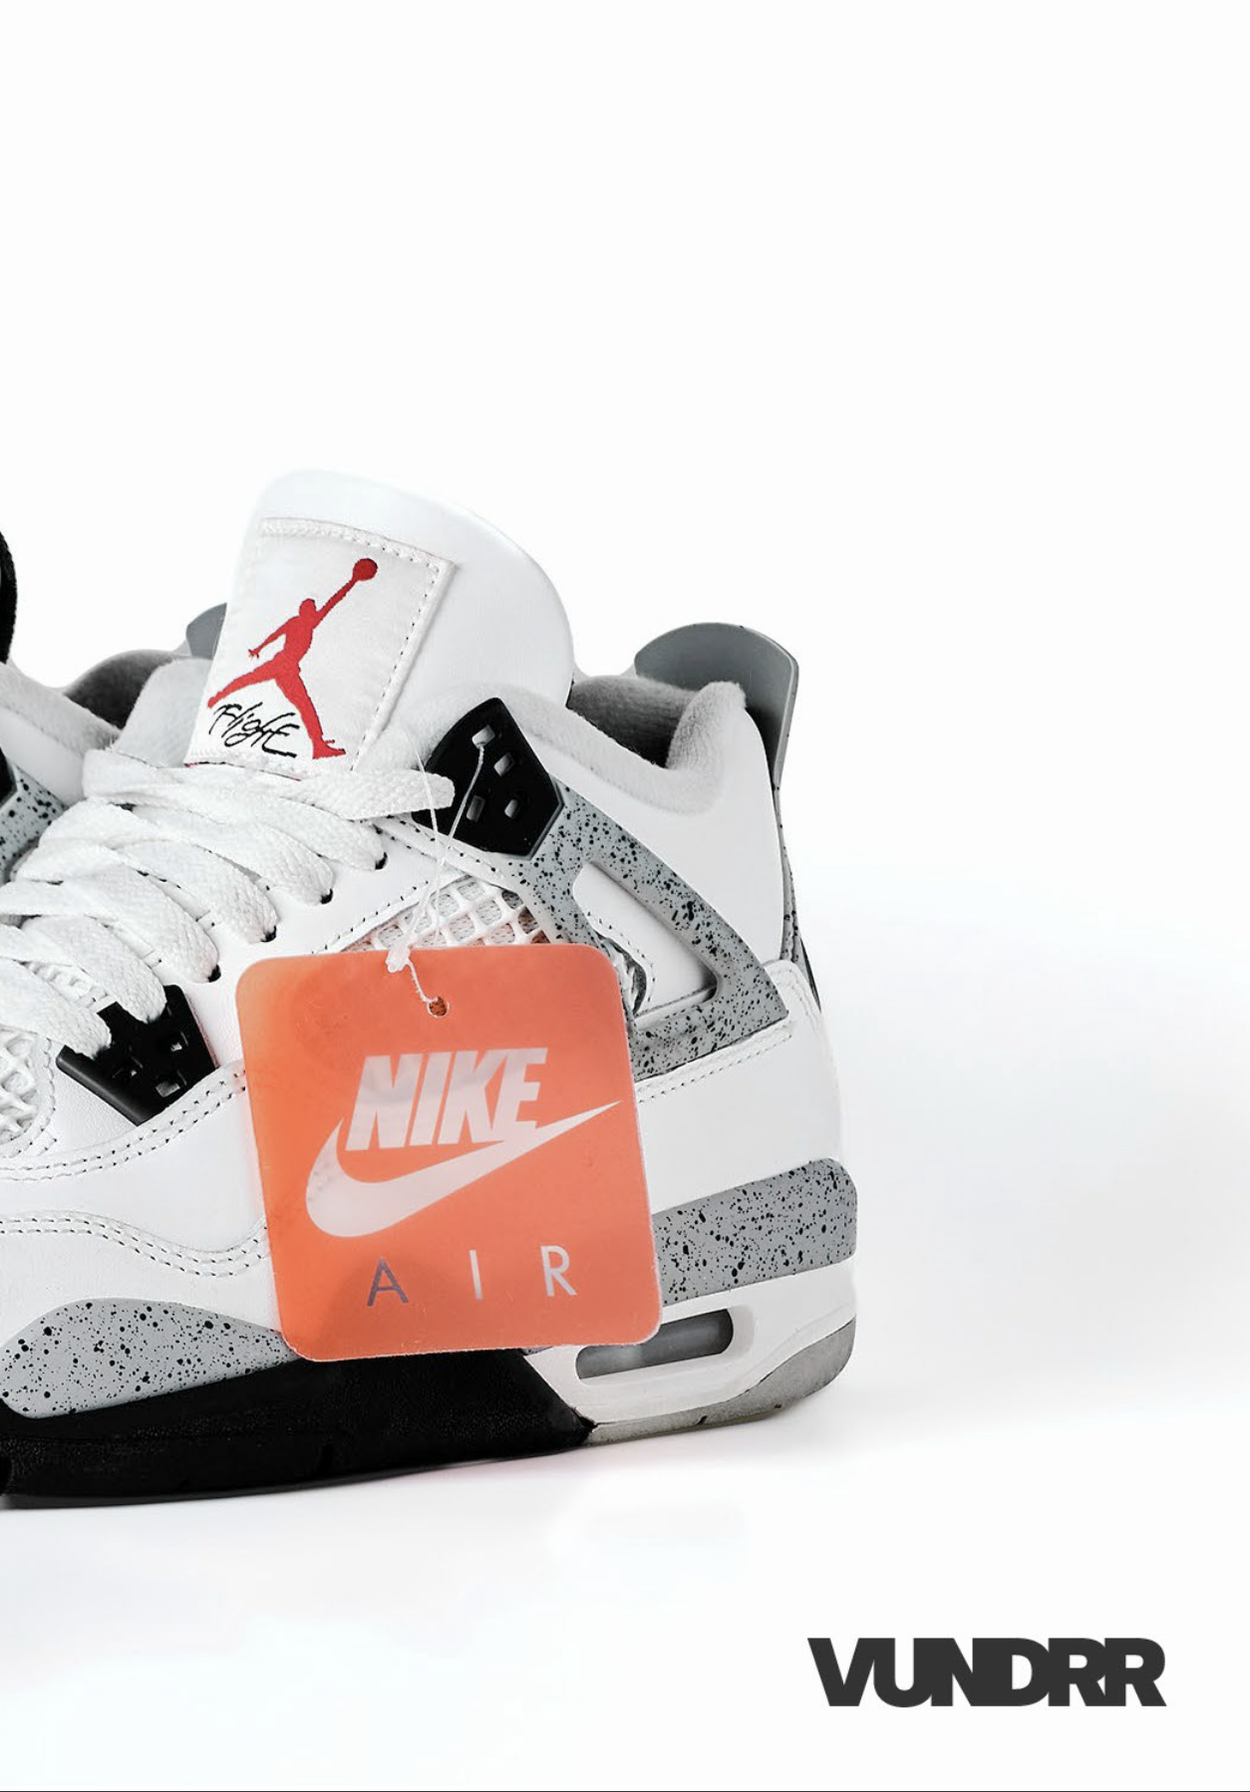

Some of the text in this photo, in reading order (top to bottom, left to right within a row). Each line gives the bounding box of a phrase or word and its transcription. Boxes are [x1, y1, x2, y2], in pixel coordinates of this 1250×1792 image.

[209, 702, 300, 758] Flight
[345, 1047, 548, 1151] NIKE
[366, 1245, 577, 1307] AIR
